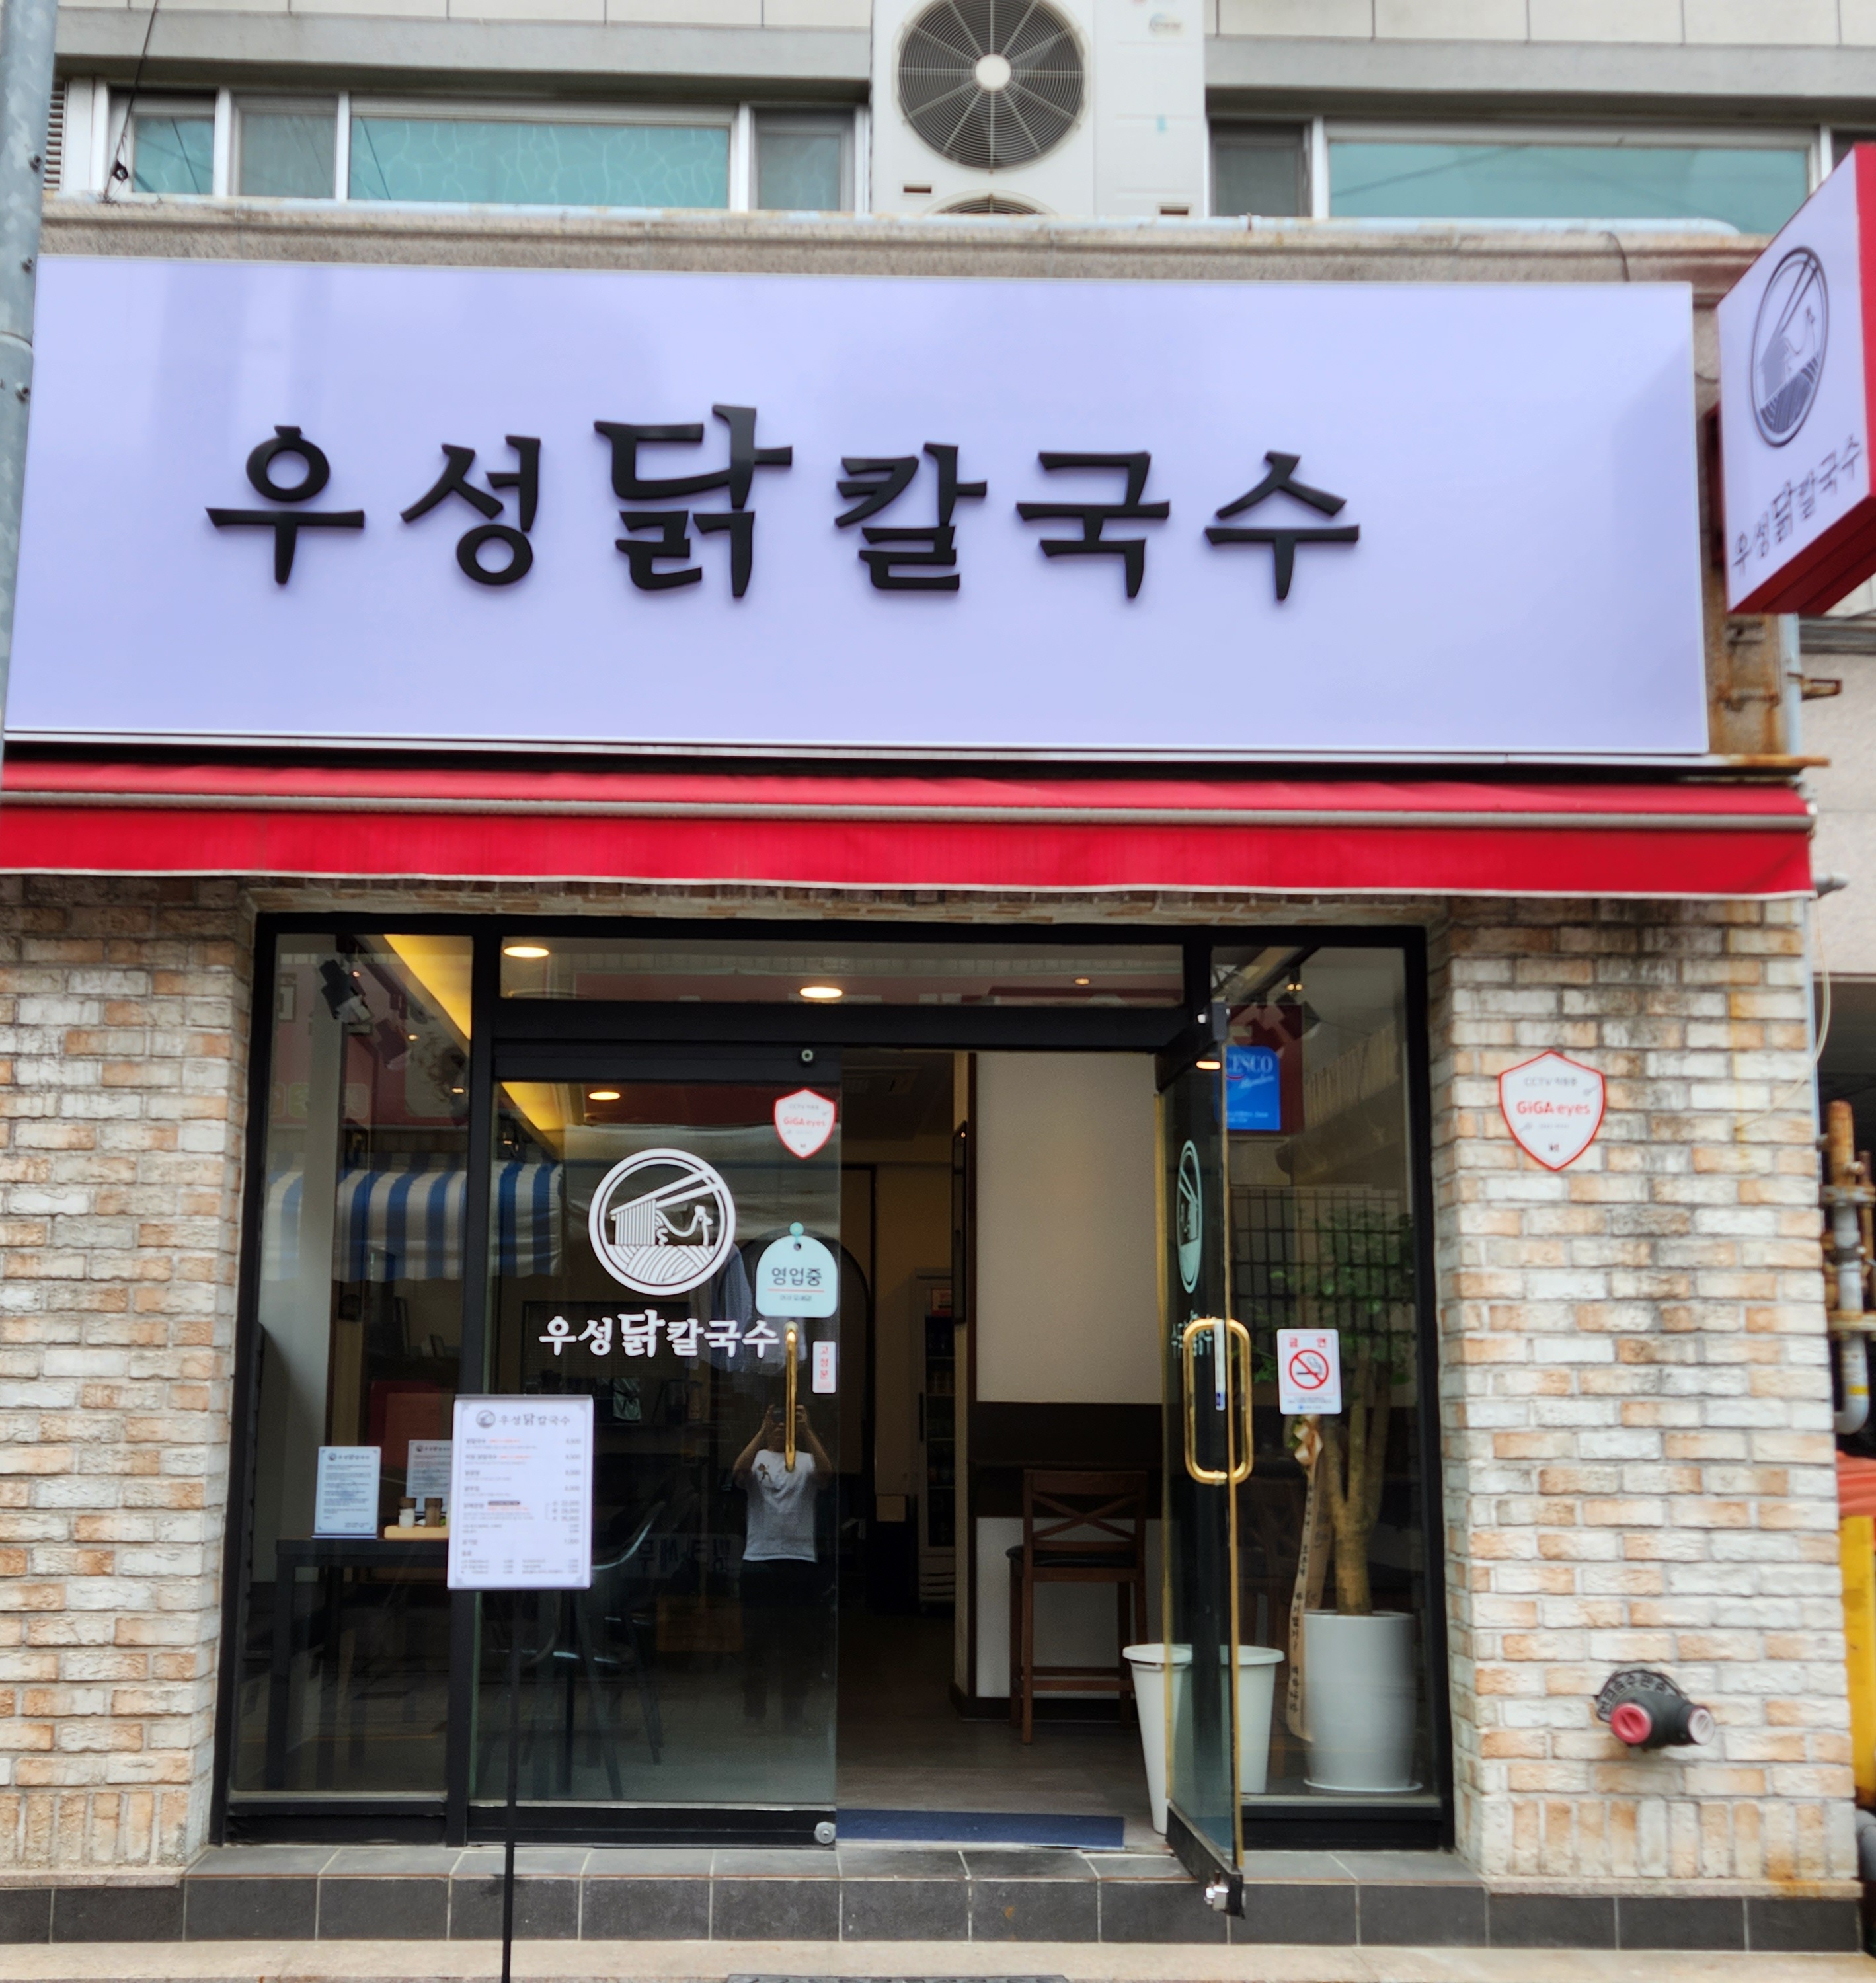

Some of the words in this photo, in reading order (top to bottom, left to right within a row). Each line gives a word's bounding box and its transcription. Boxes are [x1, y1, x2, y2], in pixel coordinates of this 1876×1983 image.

[205, 404, 1360, 603] 우성닭칼국수
[1733, 434, 1862, 577] 우성닭칼국수
[771, 1266, 822, 1287] 영업중
[538, 1309, 780, 1358] 우성닭칼국수
